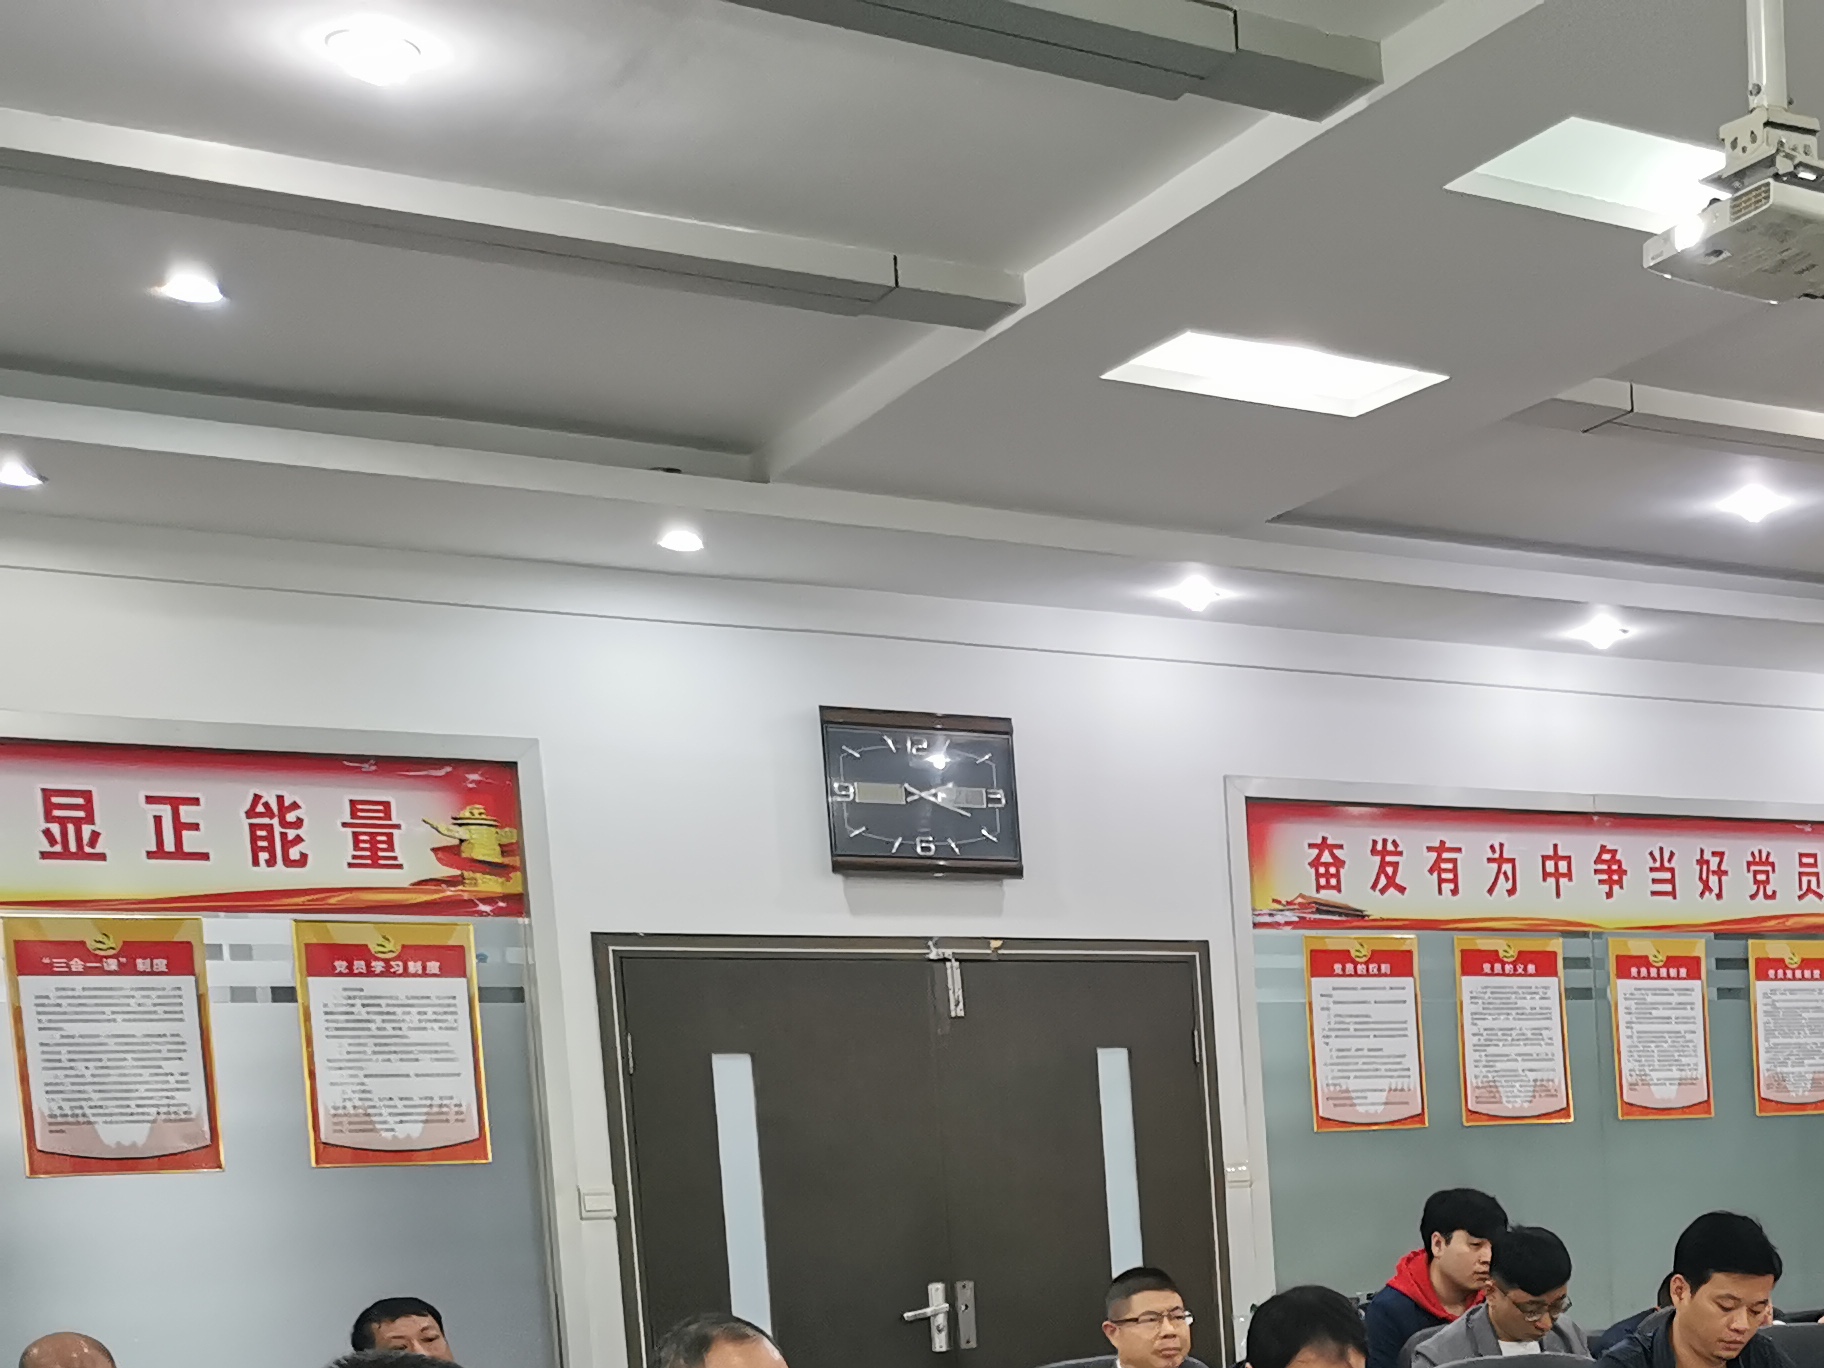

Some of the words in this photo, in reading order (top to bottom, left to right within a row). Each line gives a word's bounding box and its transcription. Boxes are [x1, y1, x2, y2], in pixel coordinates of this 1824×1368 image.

[906, 736, 928, 754] 12
[39, 787, 404, 870] 显正能量
[915, 836, 935, 856] 6
[1307, 835, 1824, 901] 奋发有为中争当好党员
[333, 960, 441, 974] 党员学习制度
